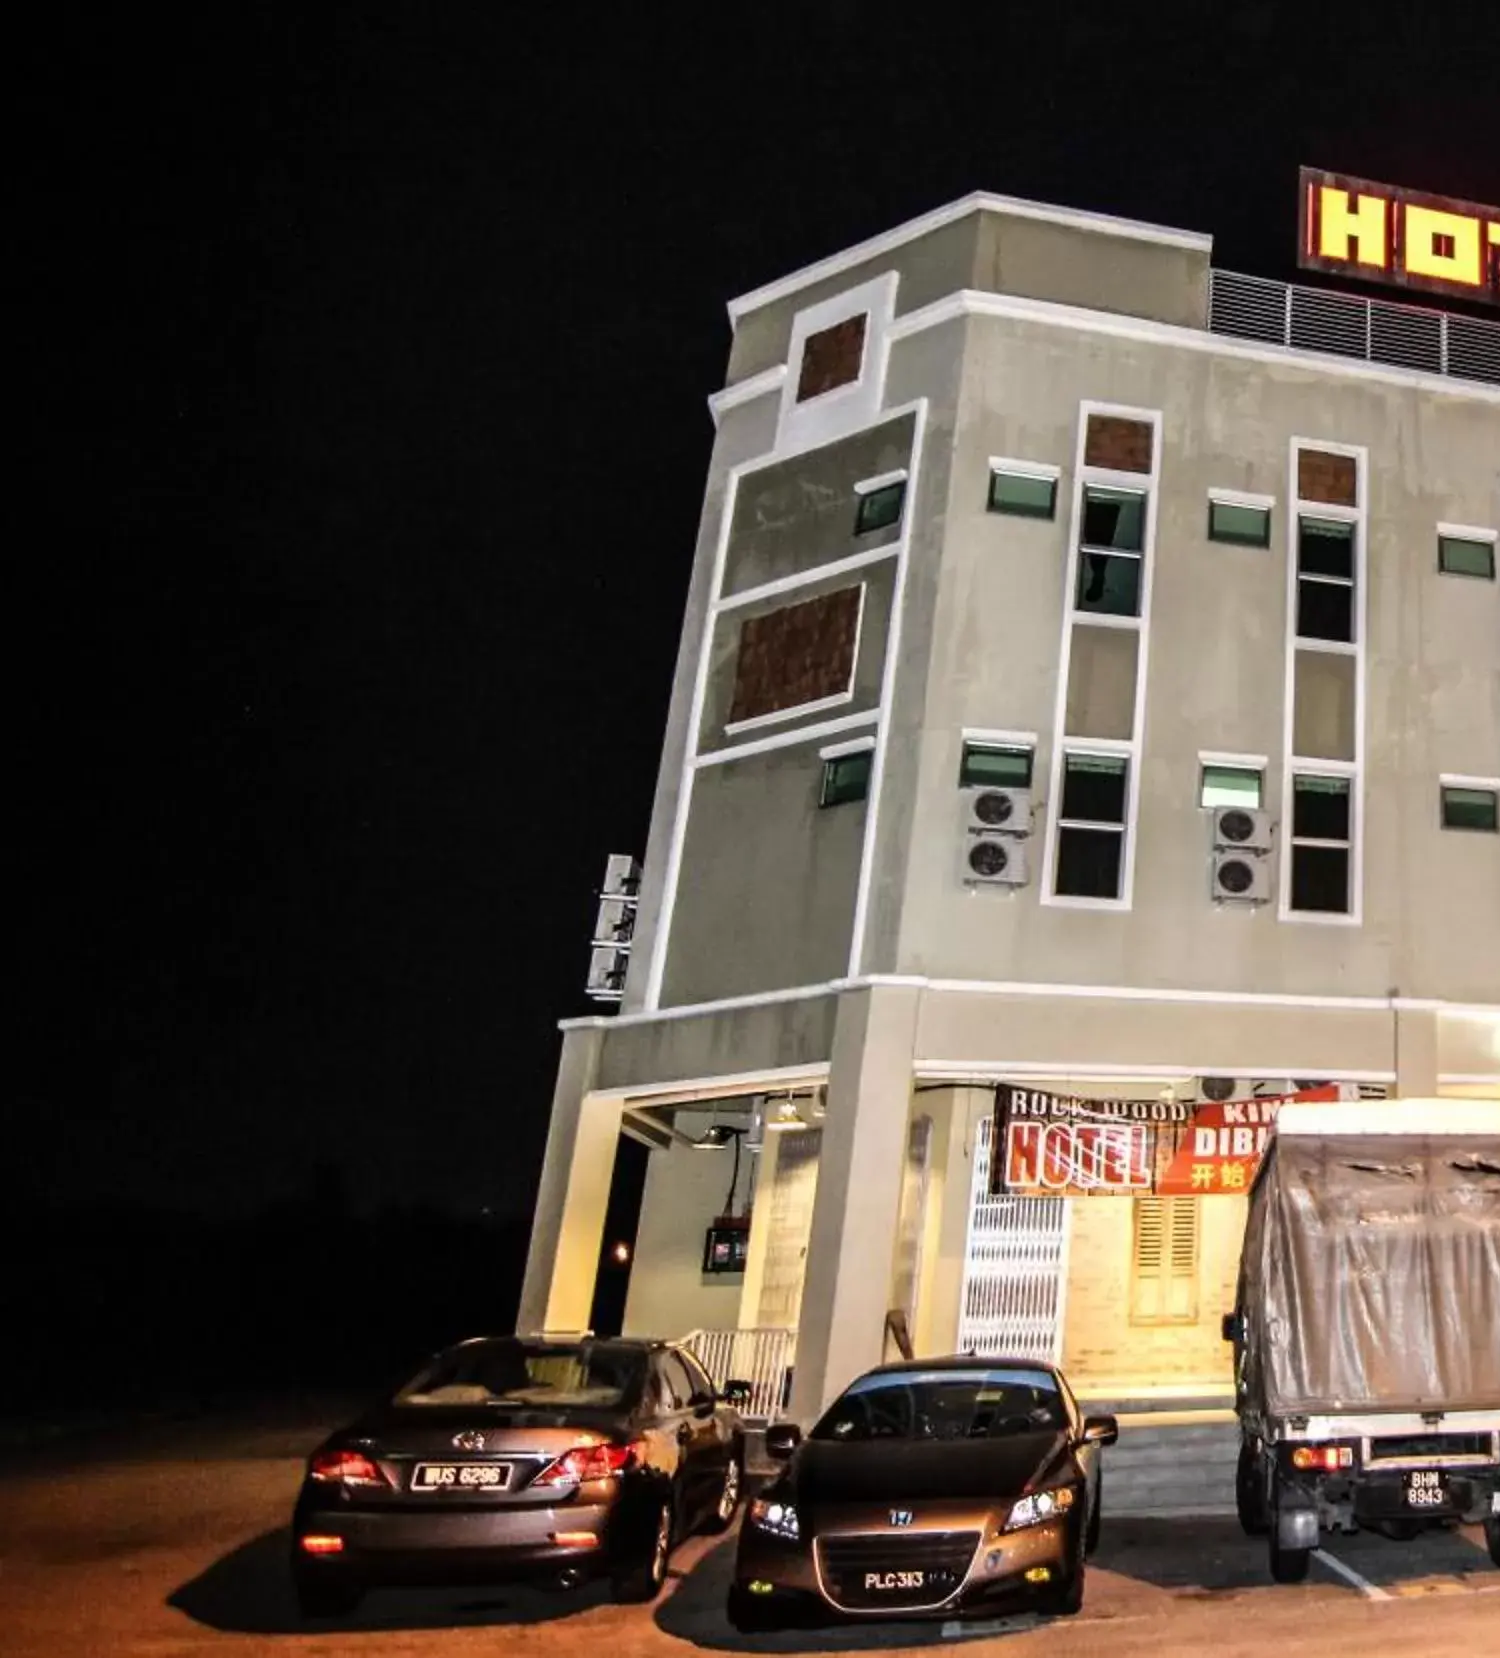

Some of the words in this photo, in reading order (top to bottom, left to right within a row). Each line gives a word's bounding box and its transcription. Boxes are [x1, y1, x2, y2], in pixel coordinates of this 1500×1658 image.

[1010, 1090, 1091, 1118] ROCK
[1103, 1103, 1187, 1121] WOOD
[1005, 1121, 1151, 1189] HOTEL
[1191, 1161, 1258, 1189] 开始
[459, 1466, 500, 1484] 6296
[1408, 1487, 1443, 1505] 8943
